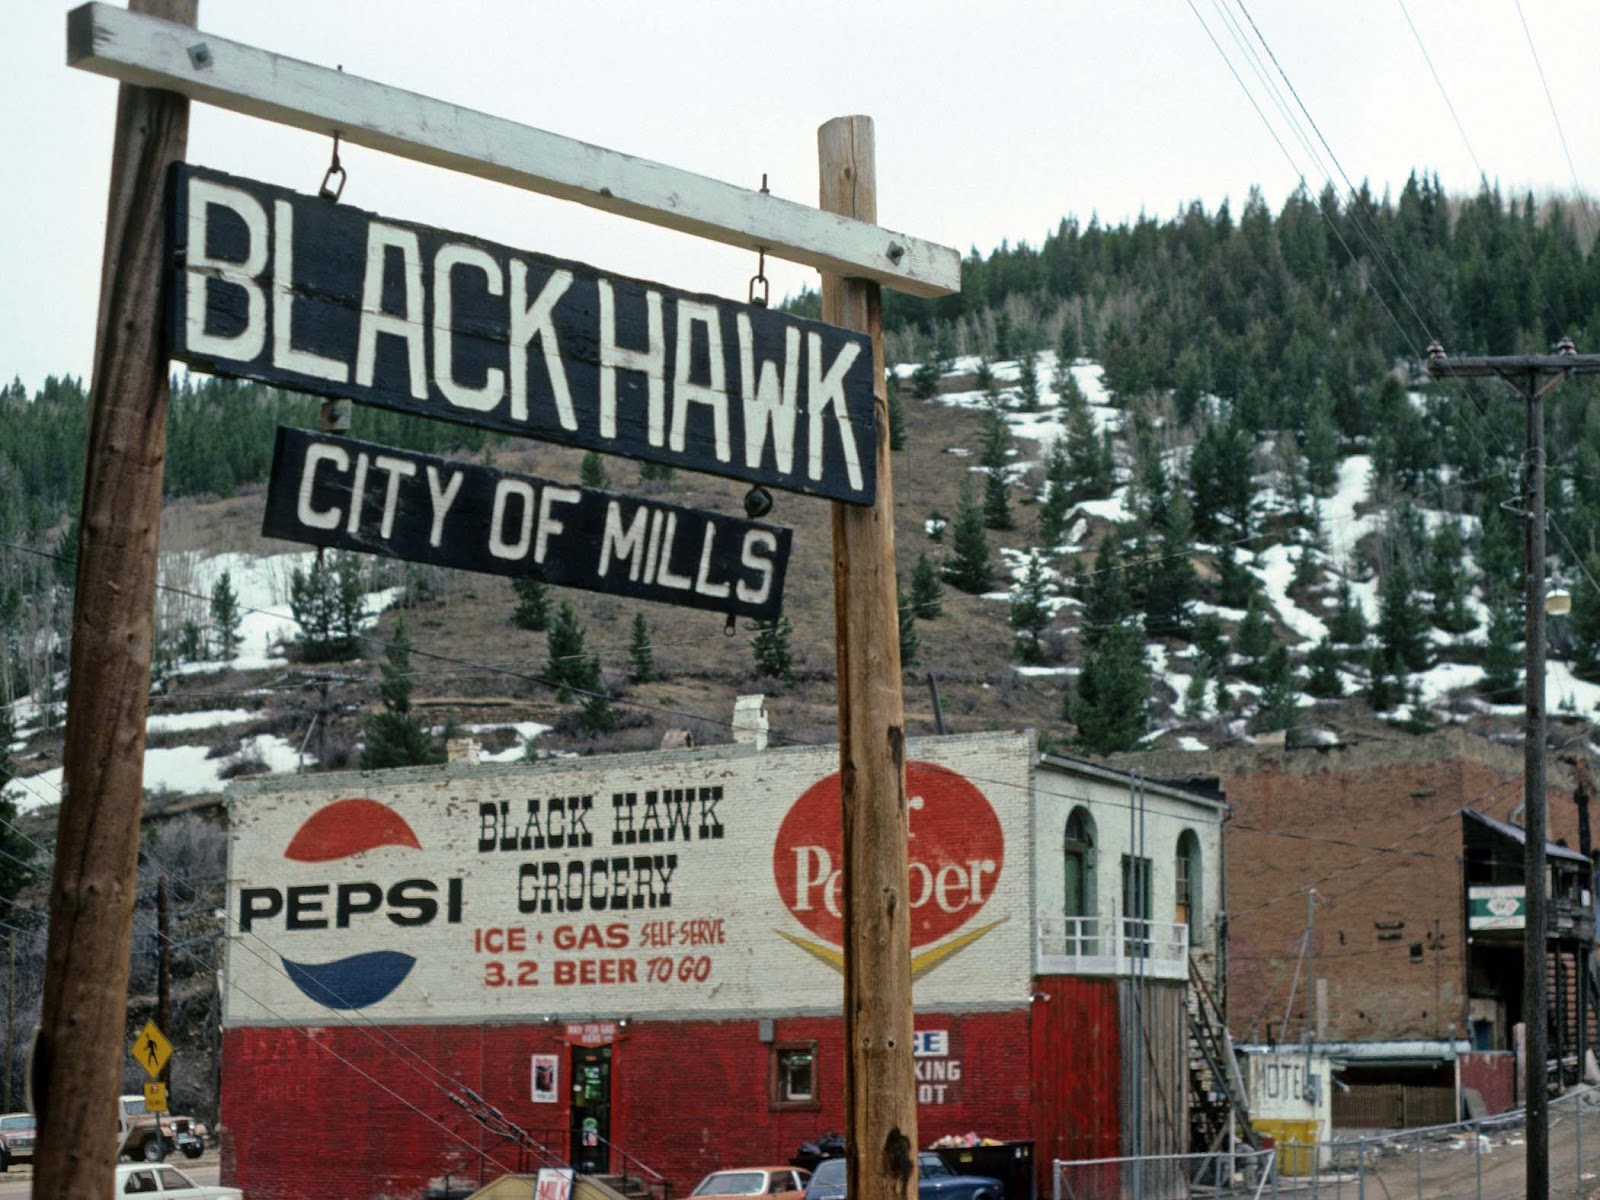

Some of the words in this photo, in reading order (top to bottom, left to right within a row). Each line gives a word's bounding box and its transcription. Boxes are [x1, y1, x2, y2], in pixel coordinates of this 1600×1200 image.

[186, 176, 578, 431] BLACK
[598, 278, 864, 491] HAWK
[297, 442, 464, 547] CITY
[488, 479, 582, 563] OF
[597, 502, 777, 604] MILLS
[478, 796, 593, 852] BLACK
[612, 786, 724, 845] HAWK
[908, 796, 925, 837] r
[239, 878, 462, 932] PEPSI
[518, 854, 678, 914] GROCERY
[474, 927, 526, 953] ICE
[553, 923, 630, 950] GAS
[484, 959, 539, 987] 3.2
[553, 958, 638, 985] BEER
[647, 957, 674, 983] TO
[677, 955, 711, 983] GO
[914, 1060, 961, 1081] KING
[918, 1083, 948, 1105] OT
